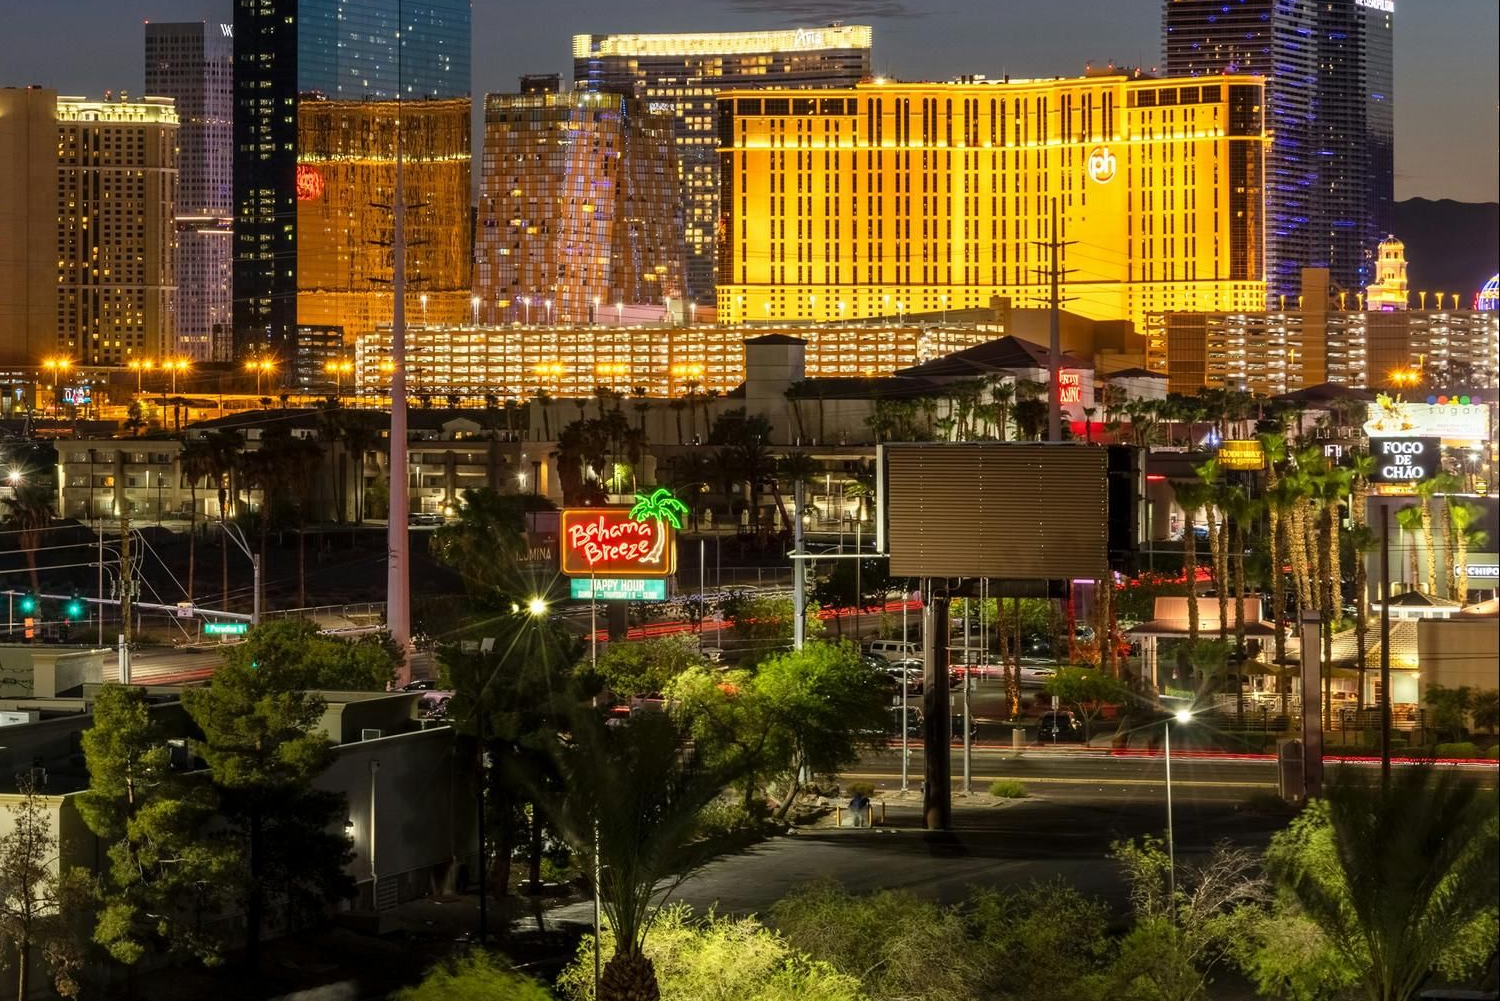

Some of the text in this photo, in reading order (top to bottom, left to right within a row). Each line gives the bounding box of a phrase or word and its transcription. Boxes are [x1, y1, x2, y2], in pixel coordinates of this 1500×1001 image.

[1429, 407, 1481, 416] sugar
[1383, 441, 1424, 455] FOGO
[1395, 455, 1412, 466] DE
[1383, 465, 1424, 479] CHÃO
[569, 515, 652, 548] Bahama
[584, 540, 650, 565] Breeze
[590, 579, 645, 591] HAPPY HOUR
